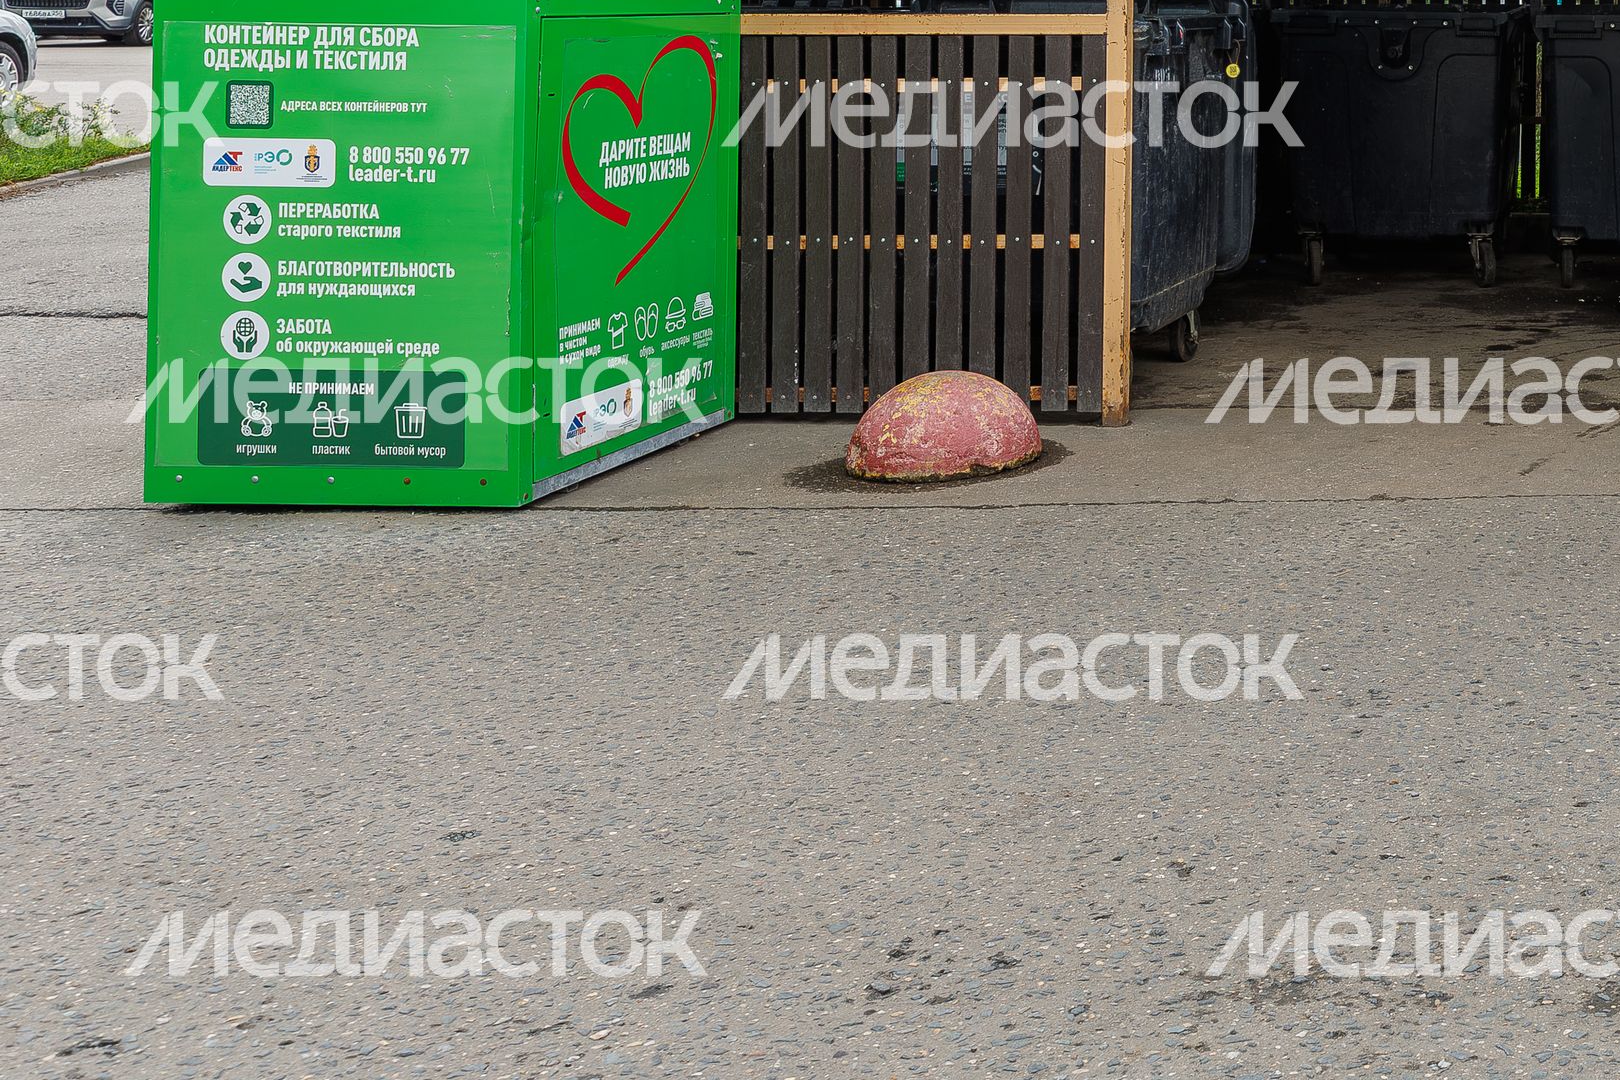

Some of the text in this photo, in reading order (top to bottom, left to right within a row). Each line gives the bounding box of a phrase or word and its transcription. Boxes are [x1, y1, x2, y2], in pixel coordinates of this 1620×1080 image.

[204, 22, 419, 49] КОНТЕЙНЕР ДЛЯ СБОРА
[204, 48, 407, 72] ОДЕЖДЫ И ТЕКСТИЛЯ
[281, 100, 427, 113] АДРЕСА ВСЕХ КОНТЕЙНЕРОВ ТУТ
[349, 146, 470, 165] 8 800 550 96 77
[599, 131, 691, 167] ДАРИТЕ ВЕЩАМ
[349, 164, 436, 183] leader-t.ru
[604, 157, 690, 189] НОВУЮ ЖИЗНЬ
[278, 202, 380, 219] ПЕРЕРАБОТКА
[277, 224, 401, 240] старого текстиля
[277, 260, 455, 279] БЛАГОТВОРИТЕЛЬНОСТЬ
[276, 282, 416, 299] для нуждающихся
[276, 318, 332, 334] ЗАБОТА
[559, 317, 600, 340] ПРИНИМАЕМ
[692, 328, 713, 341] текстиль
[276, 338, 440, 357] об окружающей среде
[565, 337, 587, 351] чистом
[661, 335, 690, 351] аксессуары
[650, 360, 713, 398] 8 800 550 96 77
[288, 382, 375, 396] НЕ ПРИНИМАЕМ
[649, 388, 697, 417] leader-t.ru
[236, 443, 277, 455] игрушки
[312, 444, 351, 455] пластик
[374, 443, 446, 458] бытовой мусор
